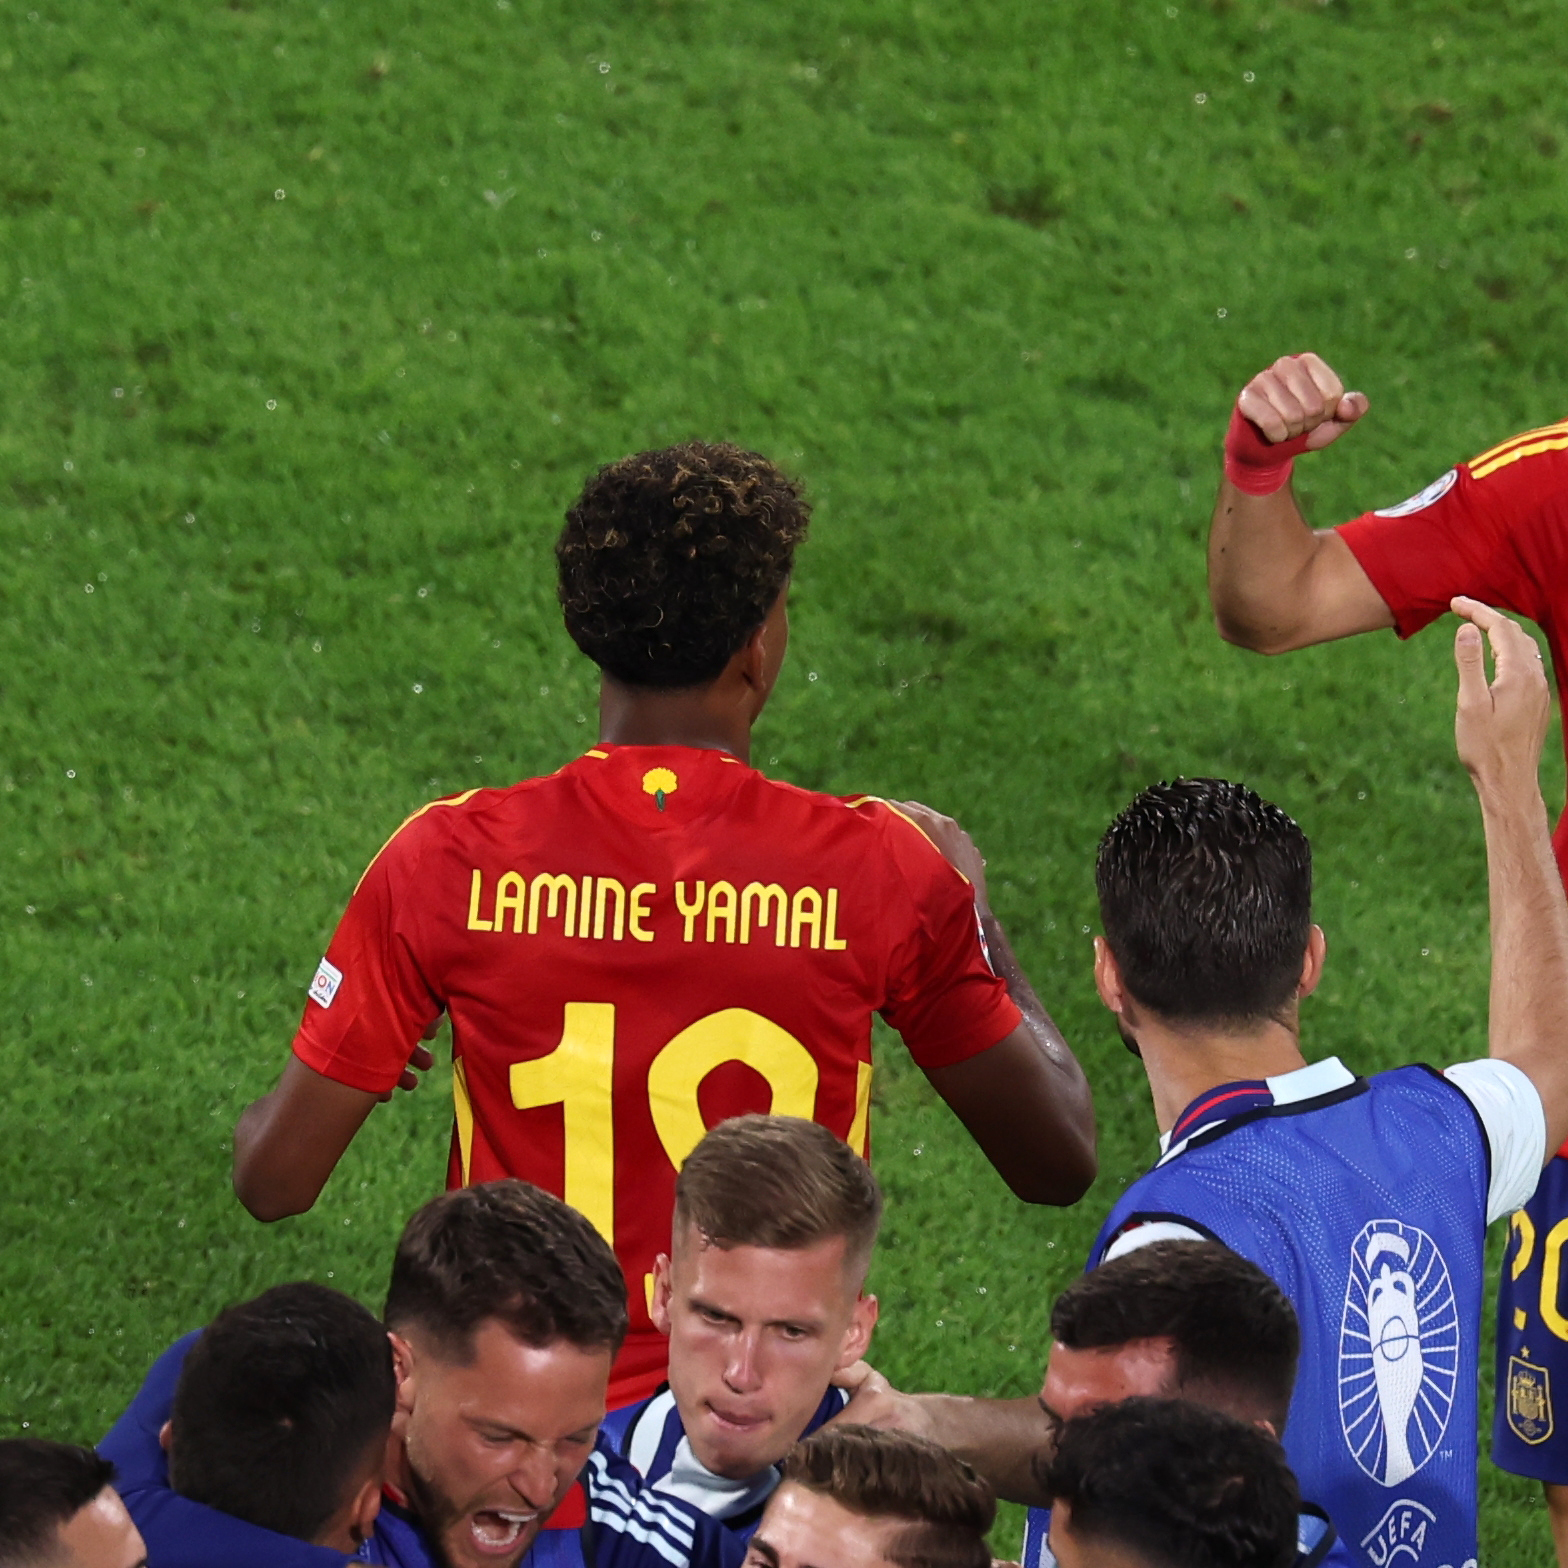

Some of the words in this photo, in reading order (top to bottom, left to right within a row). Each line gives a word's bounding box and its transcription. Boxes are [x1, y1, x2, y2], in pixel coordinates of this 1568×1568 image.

[466, 868, 657, 942] LAMINE
[675, 880, 847, 951] YAMAL
[1366, 1510, 1428, 1567] UEFA
